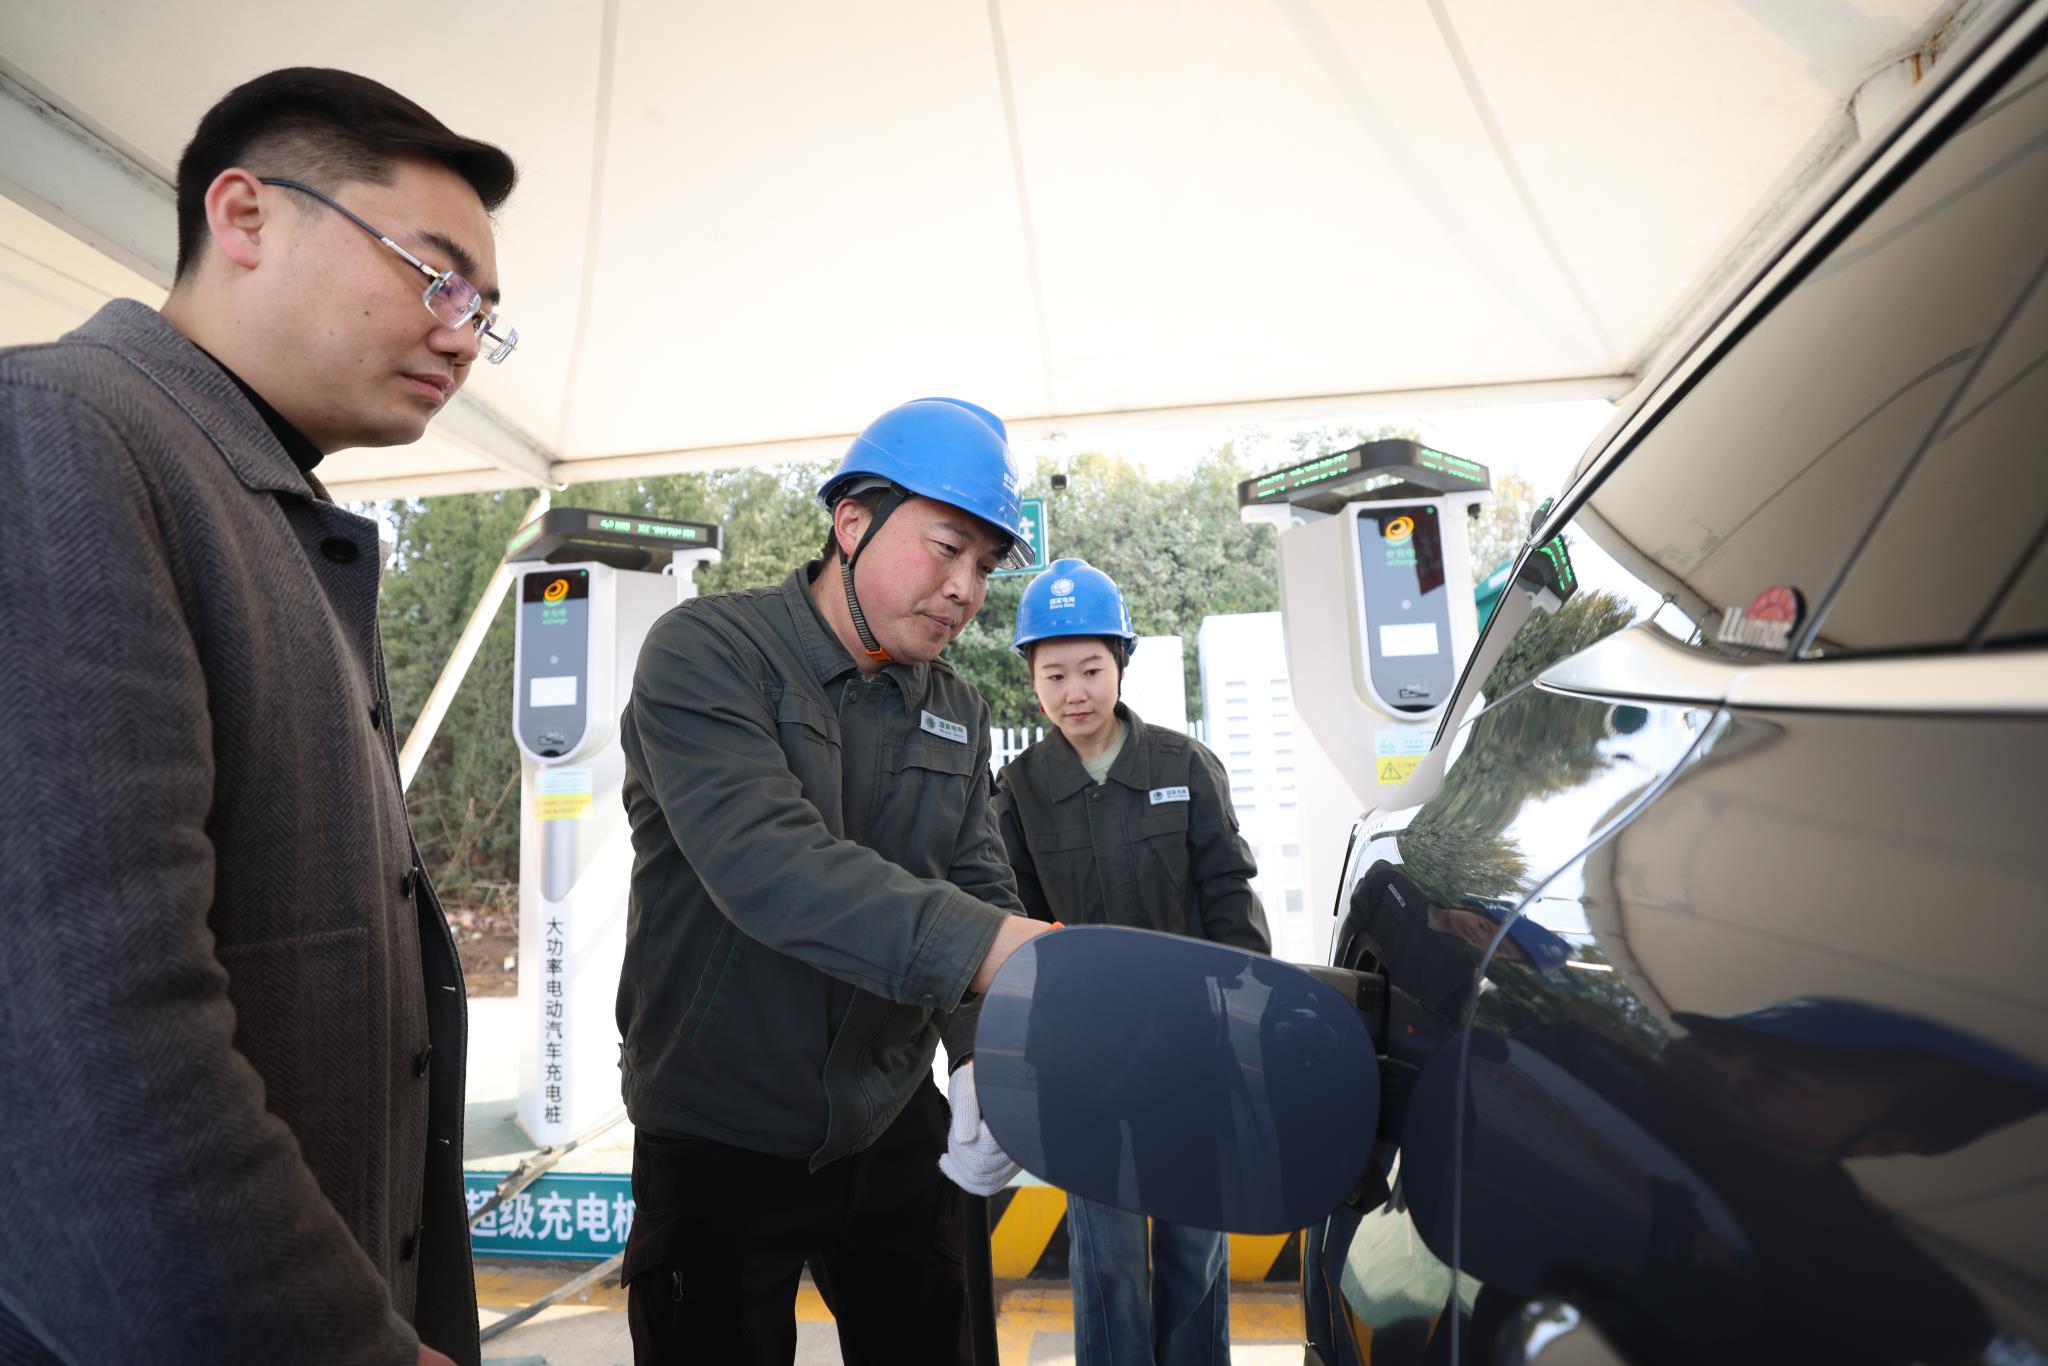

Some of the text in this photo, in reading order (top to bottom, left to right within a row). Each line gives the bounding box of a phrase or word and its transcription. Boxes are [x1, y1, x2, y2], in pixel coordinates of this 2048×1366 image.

[545, 917, 563, 1124] 大功率电动汽车充电桩
